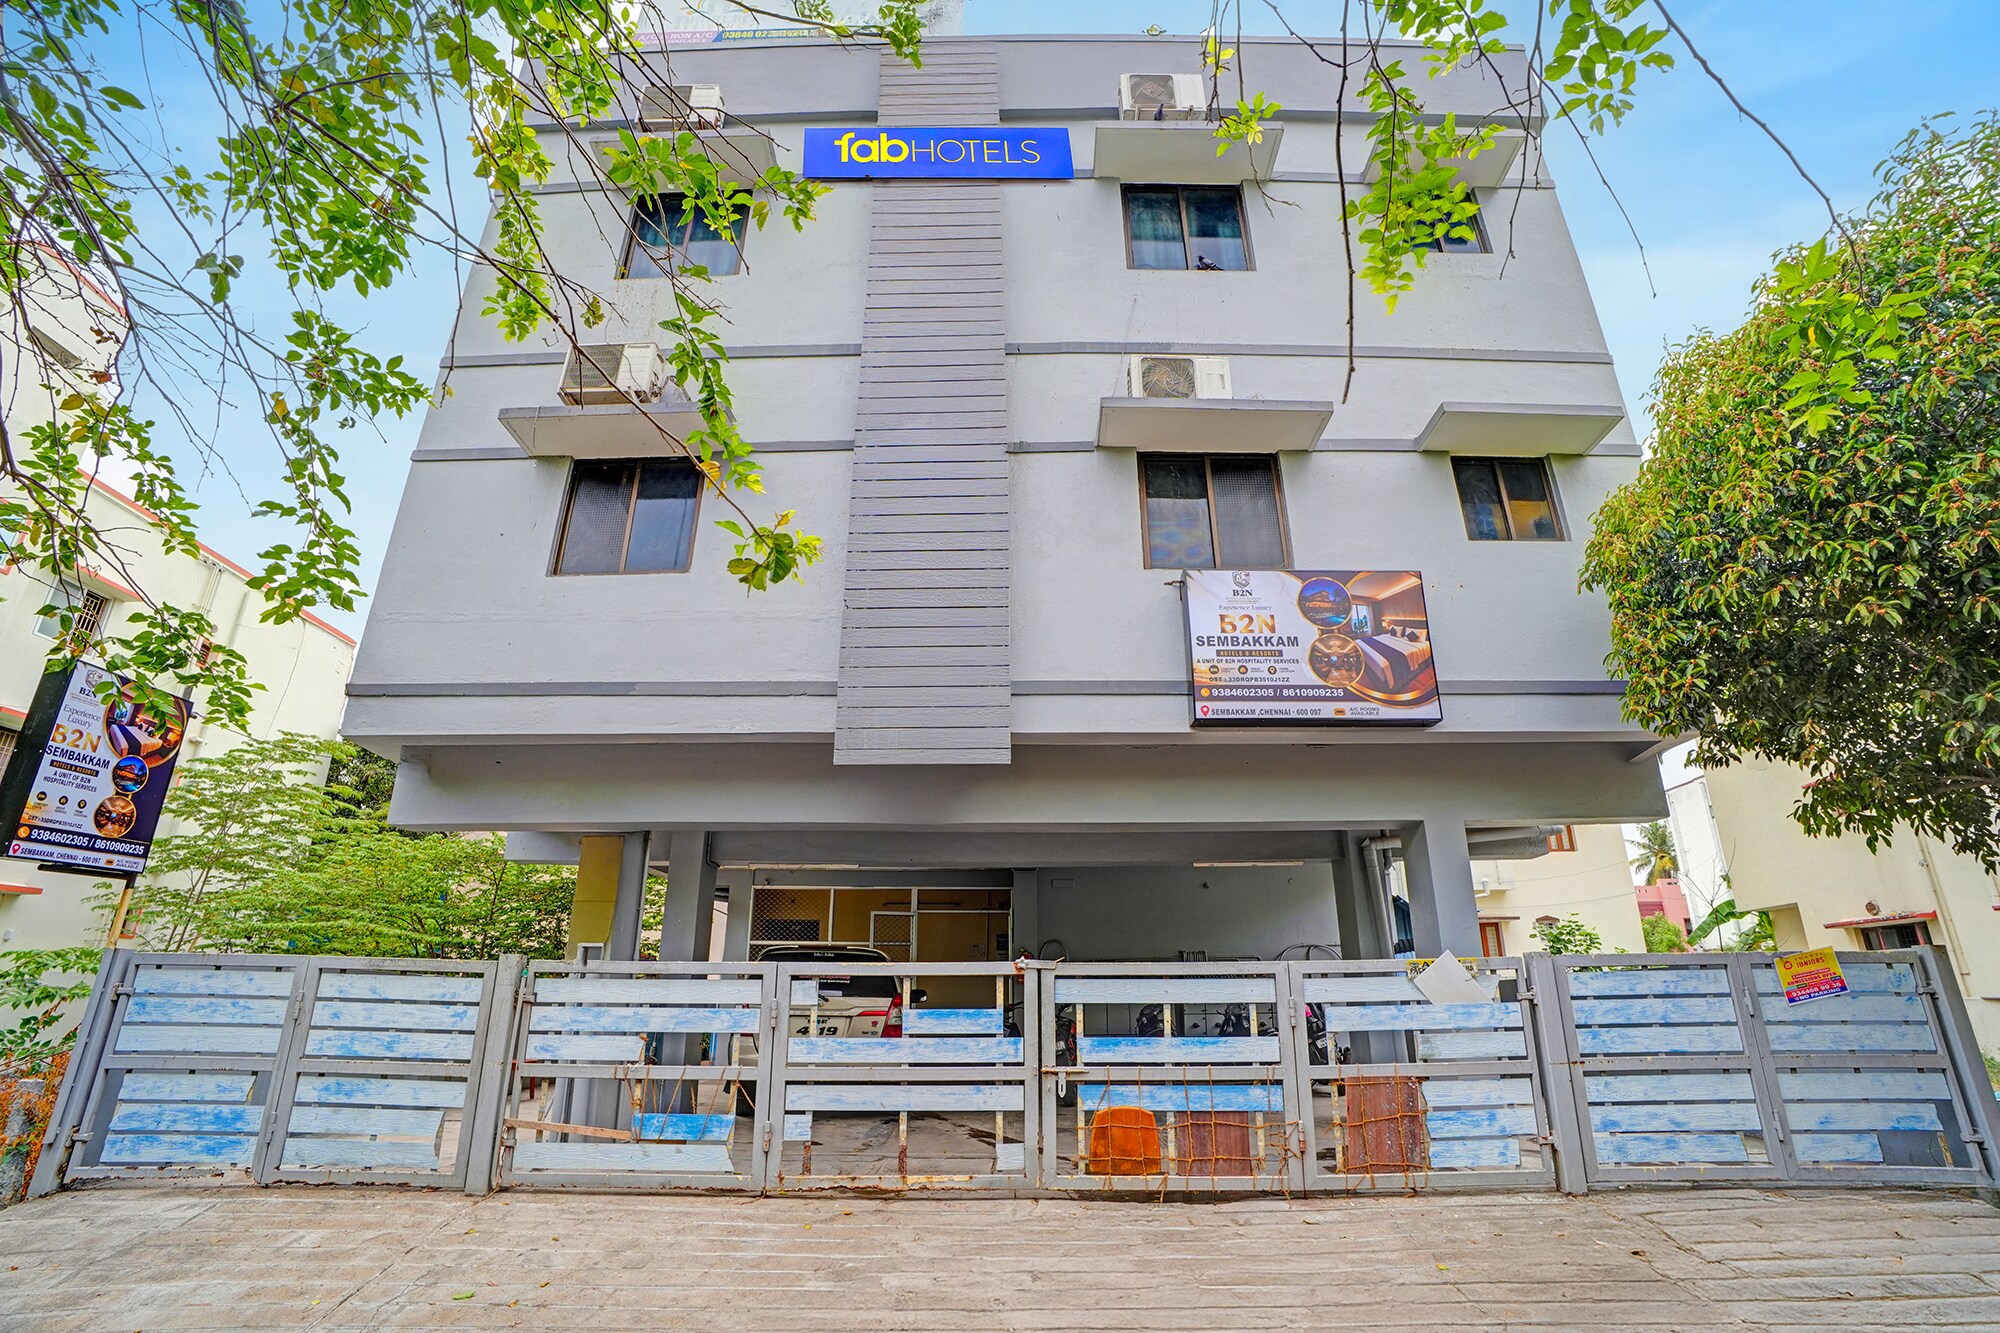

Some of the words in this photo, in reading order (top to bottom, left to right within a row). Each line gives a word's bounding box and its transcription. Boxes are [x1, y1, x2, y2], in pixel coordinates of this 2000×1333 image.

[834, 132, 1041, 164] fabHOTELS
[1232, 589, 1253, 597] B2N
[1219, 614, 1276, 634] B2N
[1196, 636, 1299, 647] SEMBAKKAM
[1212, 688, 1274, 697] 9384602305
[1282, 688, 1344, 697] 8610909235
[63, 704, 101, 721] Experience
[1296, 708, 1307, 716] 600
[1309, 708, 1321, 716] 097
[67, 715, 92, 729] Luxury
[51, 723, 101, 753] B2N
[45, 745, 110, 769] SEMBAKKAM
[52, 761, 71, 770] HOTELS
[43, 776, 74, 787] HOSPITALITY
[75, 783, 97, 792] SERVICES
[58, 771, 71, 779] UNIT
[80, 776, 91, 784] B2N
[30, 828, 88, 847] 9384602305
[89, 838, 94, 847] /
[94, 840, 144, 855] 8610909235
[20, 847, 55, 859] SEMBAKKAM,
[56, 852, 79, 861] CHENNAI
[82, 855, 91, 863] 600
[92, 856, 101, 864] 097
[1796, 957, 1826, 969] JUNIORS
[1787, 975, 1821, 986] ADMISSIONS
[1822, 971, 1837, 979] OPEN
[1810, 987, 1841, 998] PARKING
